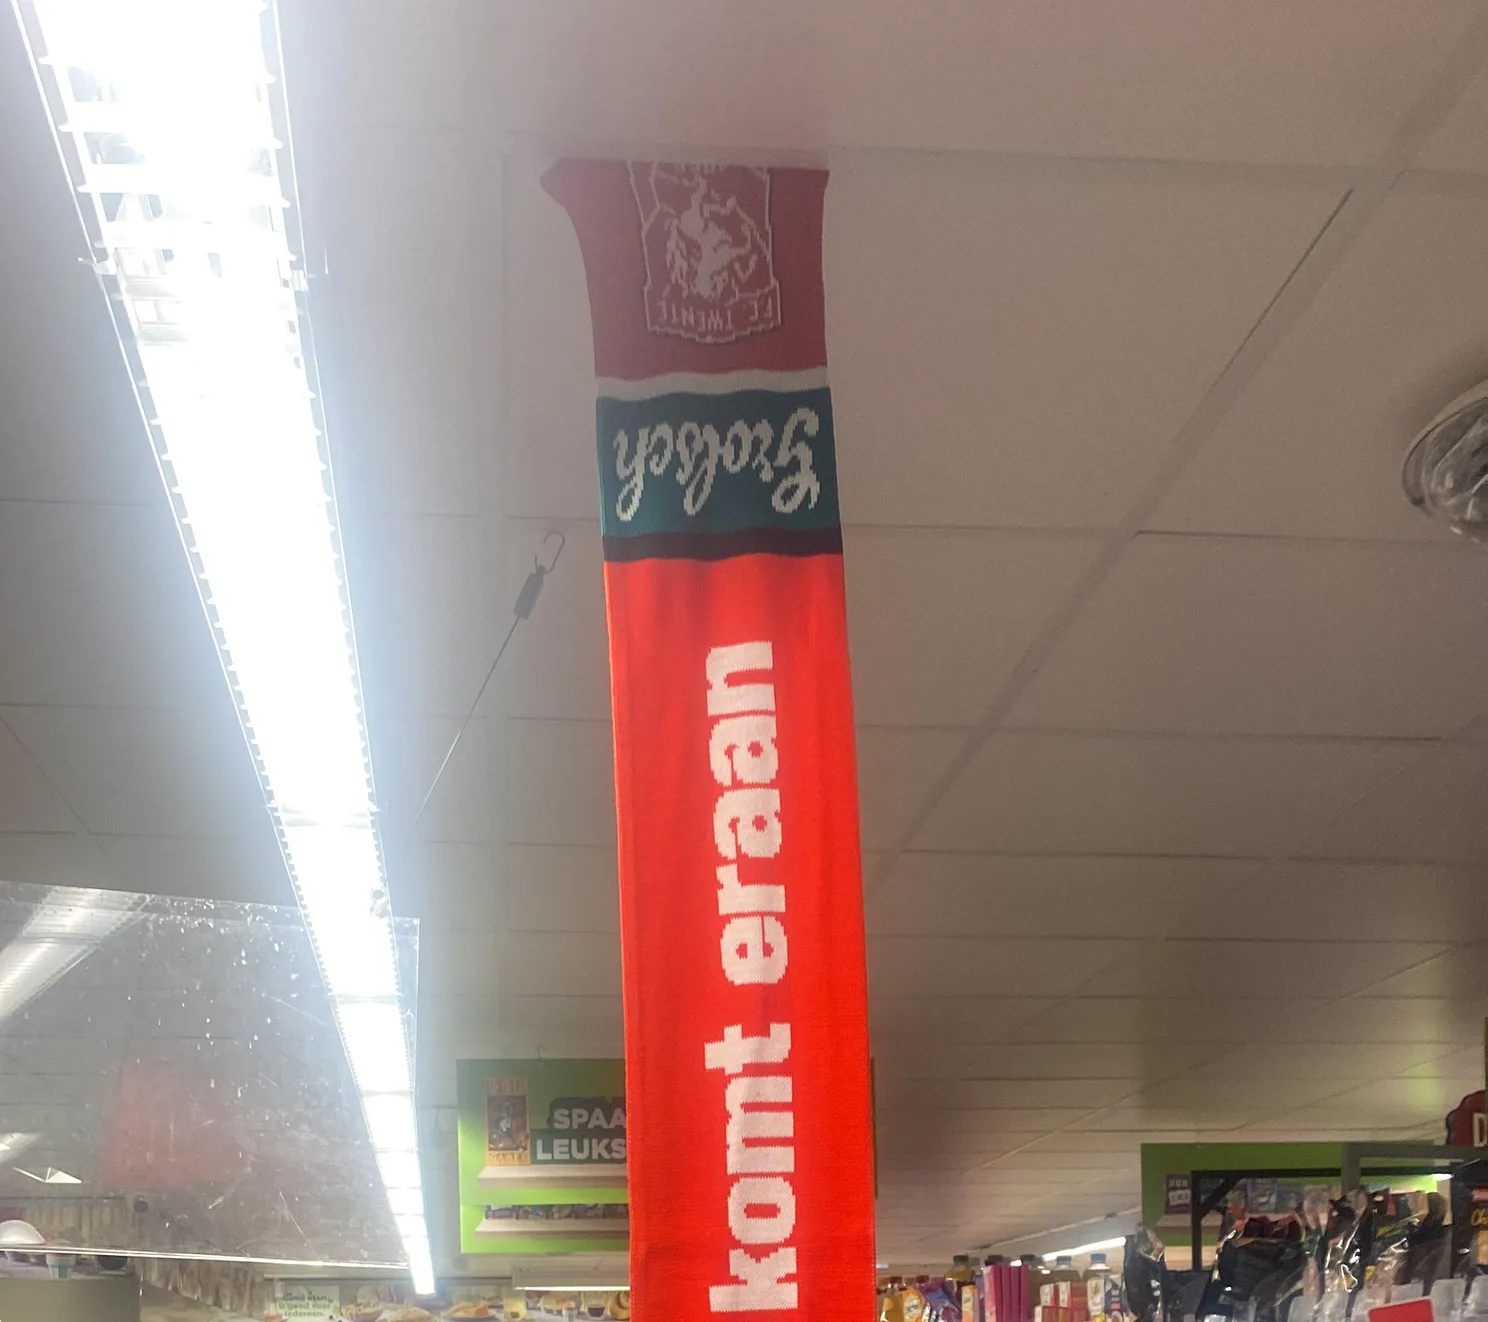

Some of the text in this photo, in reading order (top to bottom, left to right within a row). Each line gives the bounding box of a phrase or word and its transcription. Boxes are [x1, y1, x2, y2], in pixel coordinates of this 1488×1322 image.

[613, 407, 820, 521] Grolsch
[705, 641, 789, 985] eraan
[536, 1138, 627, 1160] LEUKS
[553, 1107, 627, 1129] SPAA
[704, 1022, 799, 1312] komt
